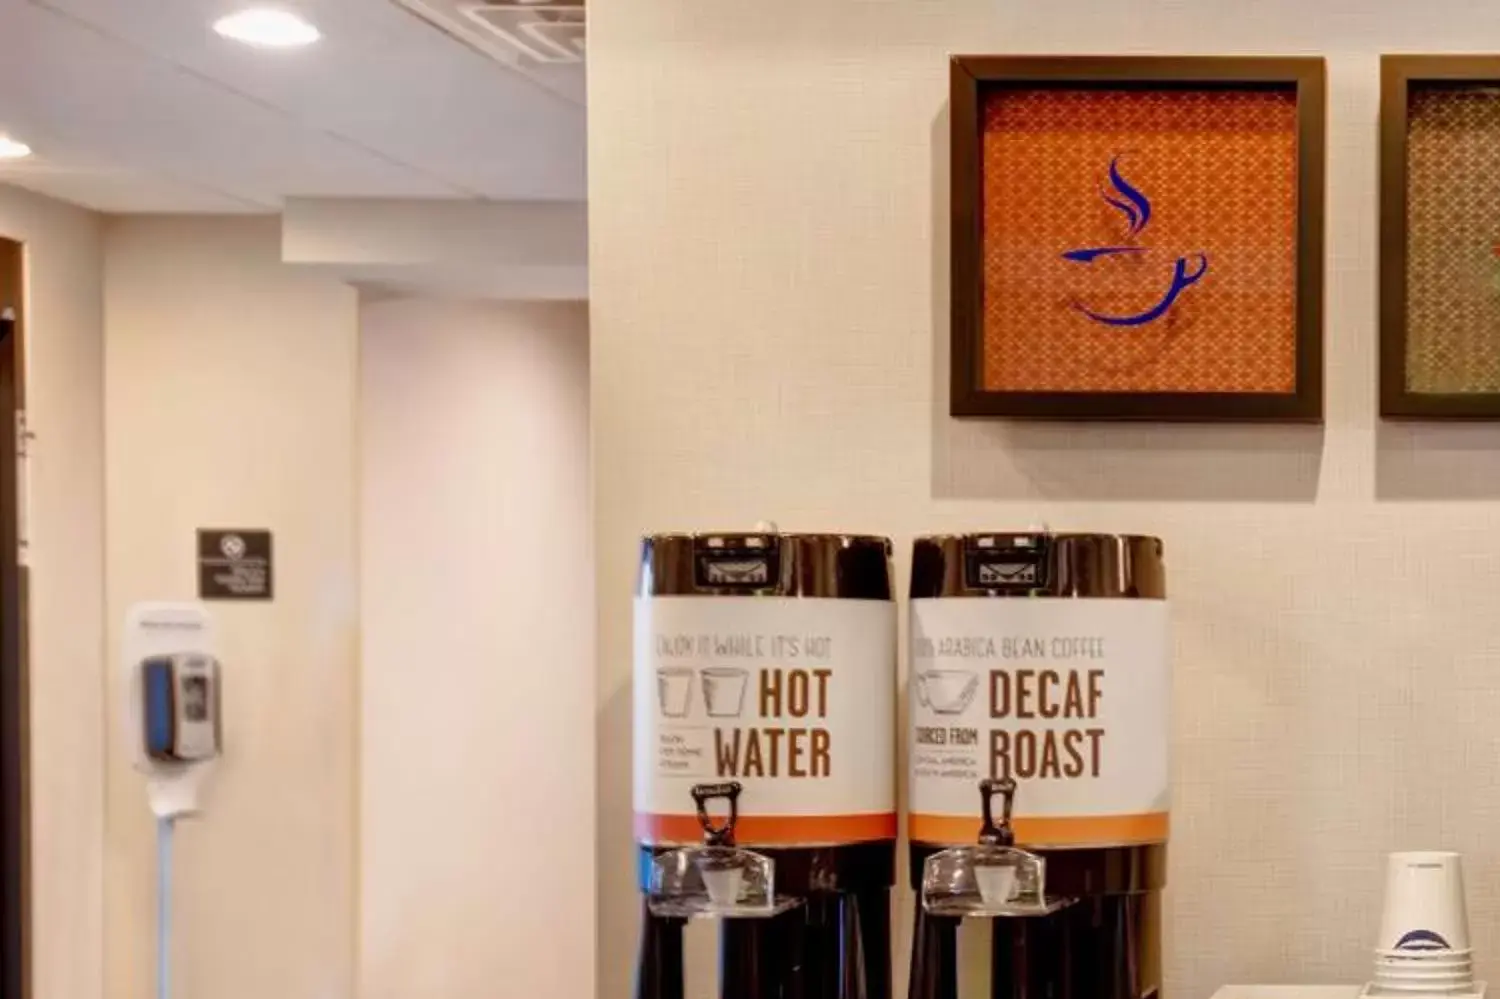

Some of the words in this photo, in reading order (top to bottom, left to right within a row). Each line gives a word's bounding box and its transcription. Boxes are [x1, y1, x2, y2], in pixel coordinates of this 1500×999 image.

[713, 634, 765, 658] WHILE
[771, 635, 800, 658] IT'S
[804, 636, 833, 659] HOT
[1001, 637, 1045, 659] BEAN
[1050, 637, 1105, 659] COFFEE
[758, 668, 833, 718] HOT
[989, 669, 1105, 719] DECAF
[714, 727, 832, 778] WATER
[949, 727, 978, 745] FROM
[989, 729, 1105, 780] ROAST
